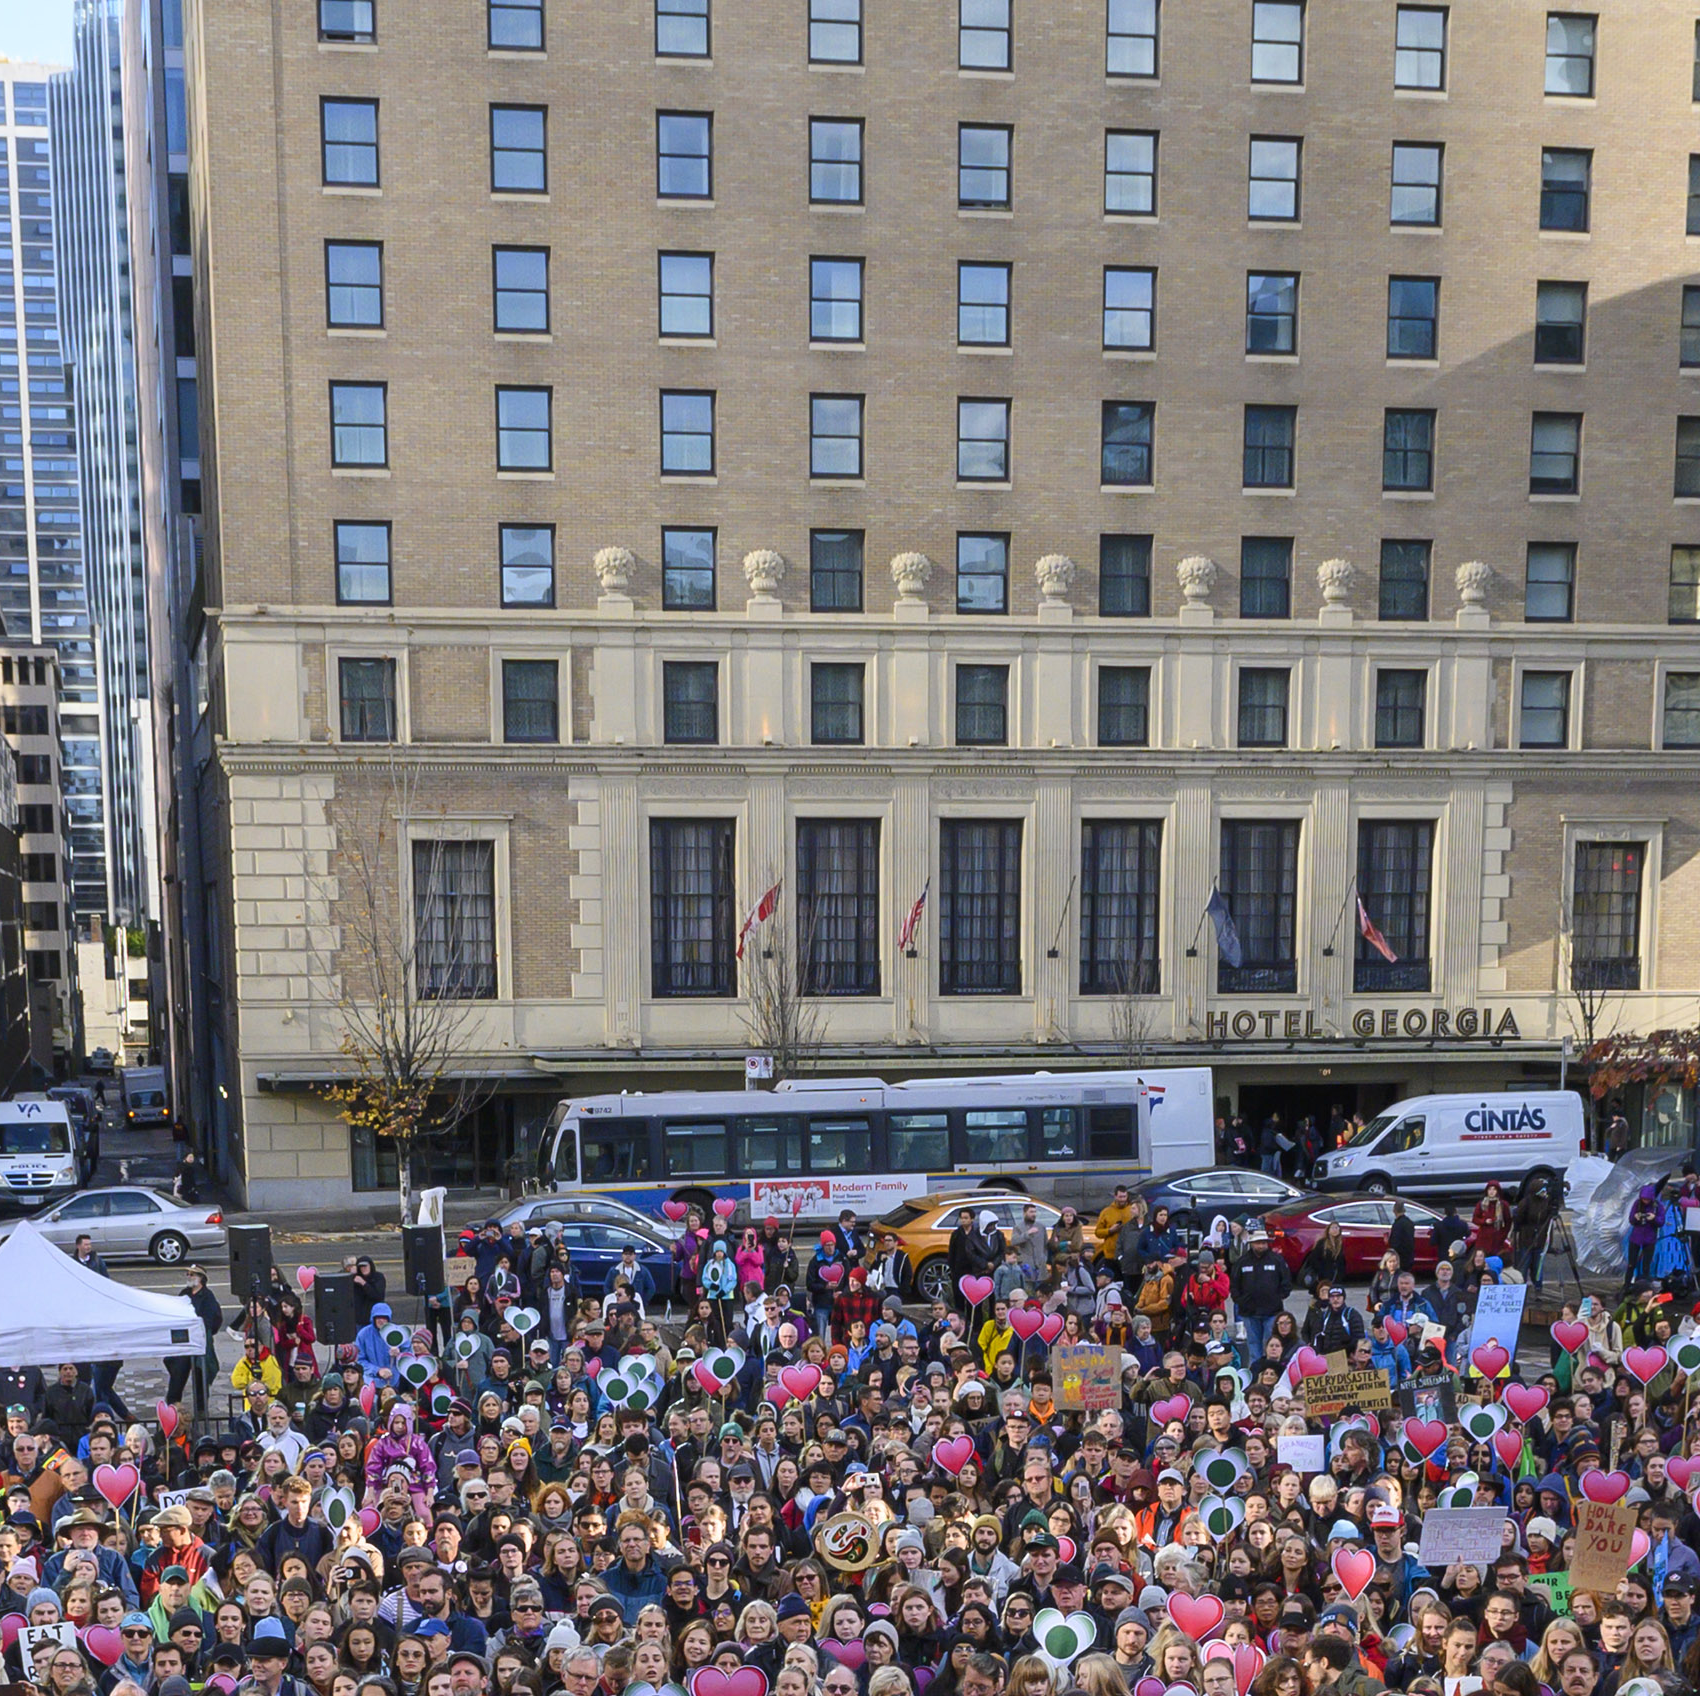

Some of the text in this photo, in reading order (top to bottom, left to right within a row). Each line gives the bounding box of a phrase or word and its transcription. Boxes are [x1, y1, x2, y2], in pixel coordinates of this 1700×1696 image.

[1206, 1007, 1519, 1039] HOTEL GEORGIA
[832, 1181, 908, 1192] Modern Family
[1306, 1369, 1381, 1388] EVERY DISASTER
[1307, 1381, 1387, 1396] MOVIE STARTS WITH THE
[1307, 1392, 1359, 1405] GOVERNMENT
[1587, 1504, 1617, 1519] HOW
[1584, 1519, 1627, 1536] DARE
[1589, 1535, 1623, 1553] YOU
[27, 1625, 63, 1643] EAT
